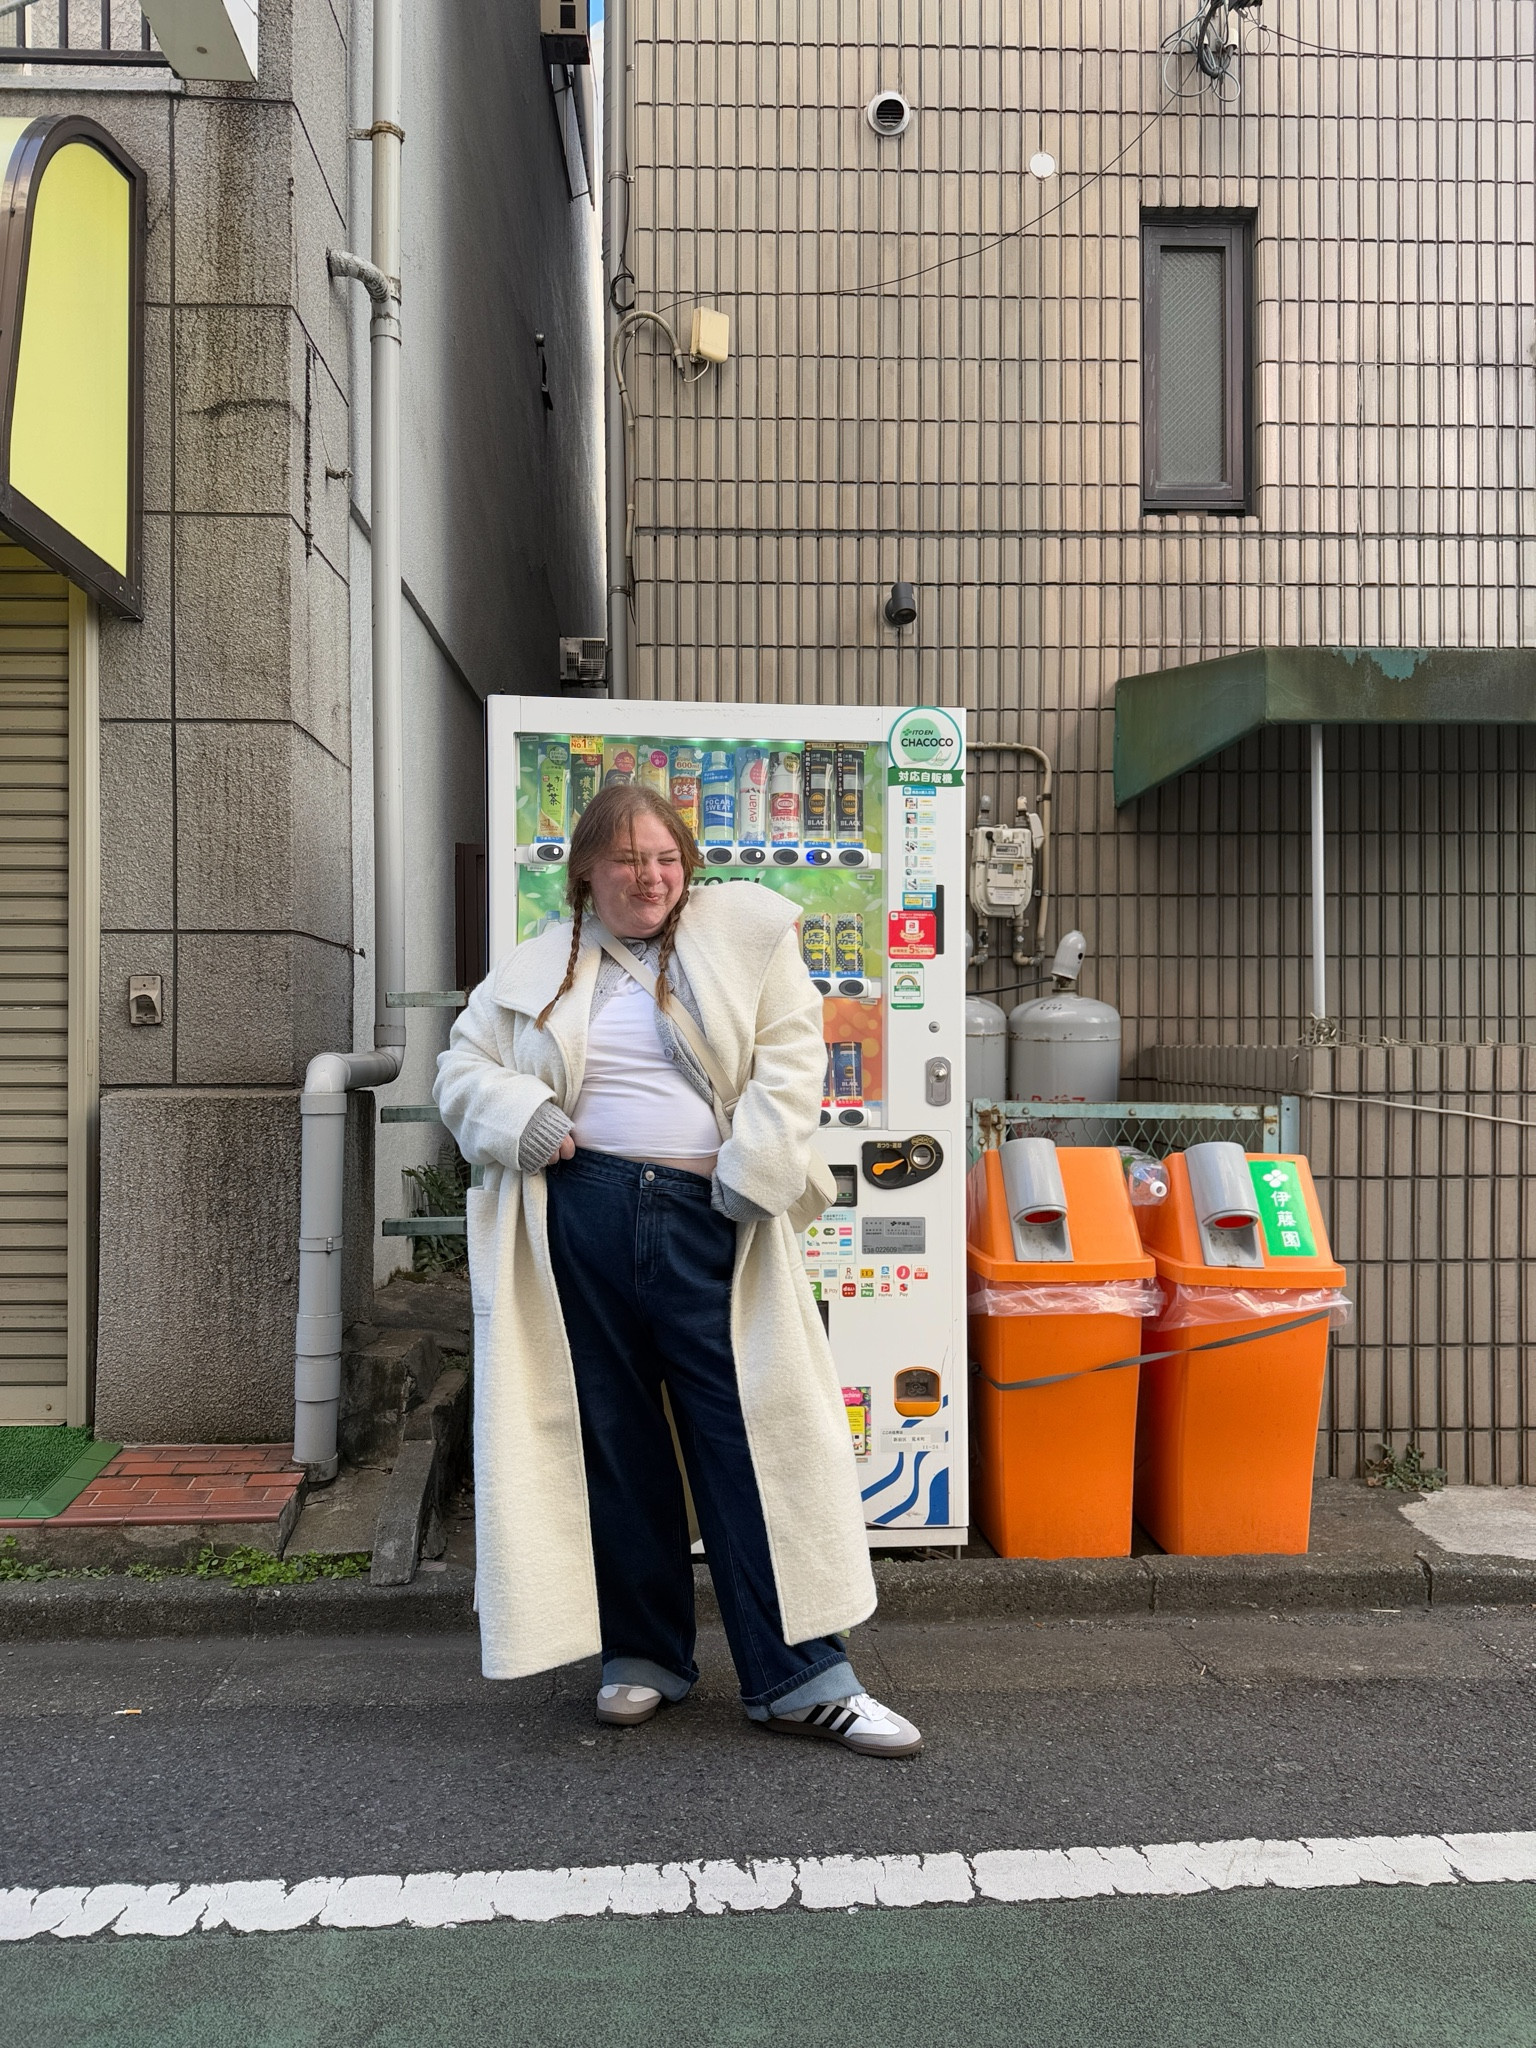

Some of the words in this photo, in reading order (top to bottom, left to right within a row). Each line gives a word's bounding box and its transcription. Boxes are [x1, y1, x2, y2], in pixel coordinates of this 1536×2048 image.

[901, 738, 954, 747] CHACOCO
[898, 771, 953, 784] 対応自販機
[673, 783, 698, 796] むぎ茶
[705, 799, 733, 807] POCARI
[748, 793, 758, 823] evian
[1270, 1190, 1301, 1250] 伊藤園
[875, 1246, 898, 1254] 022609
